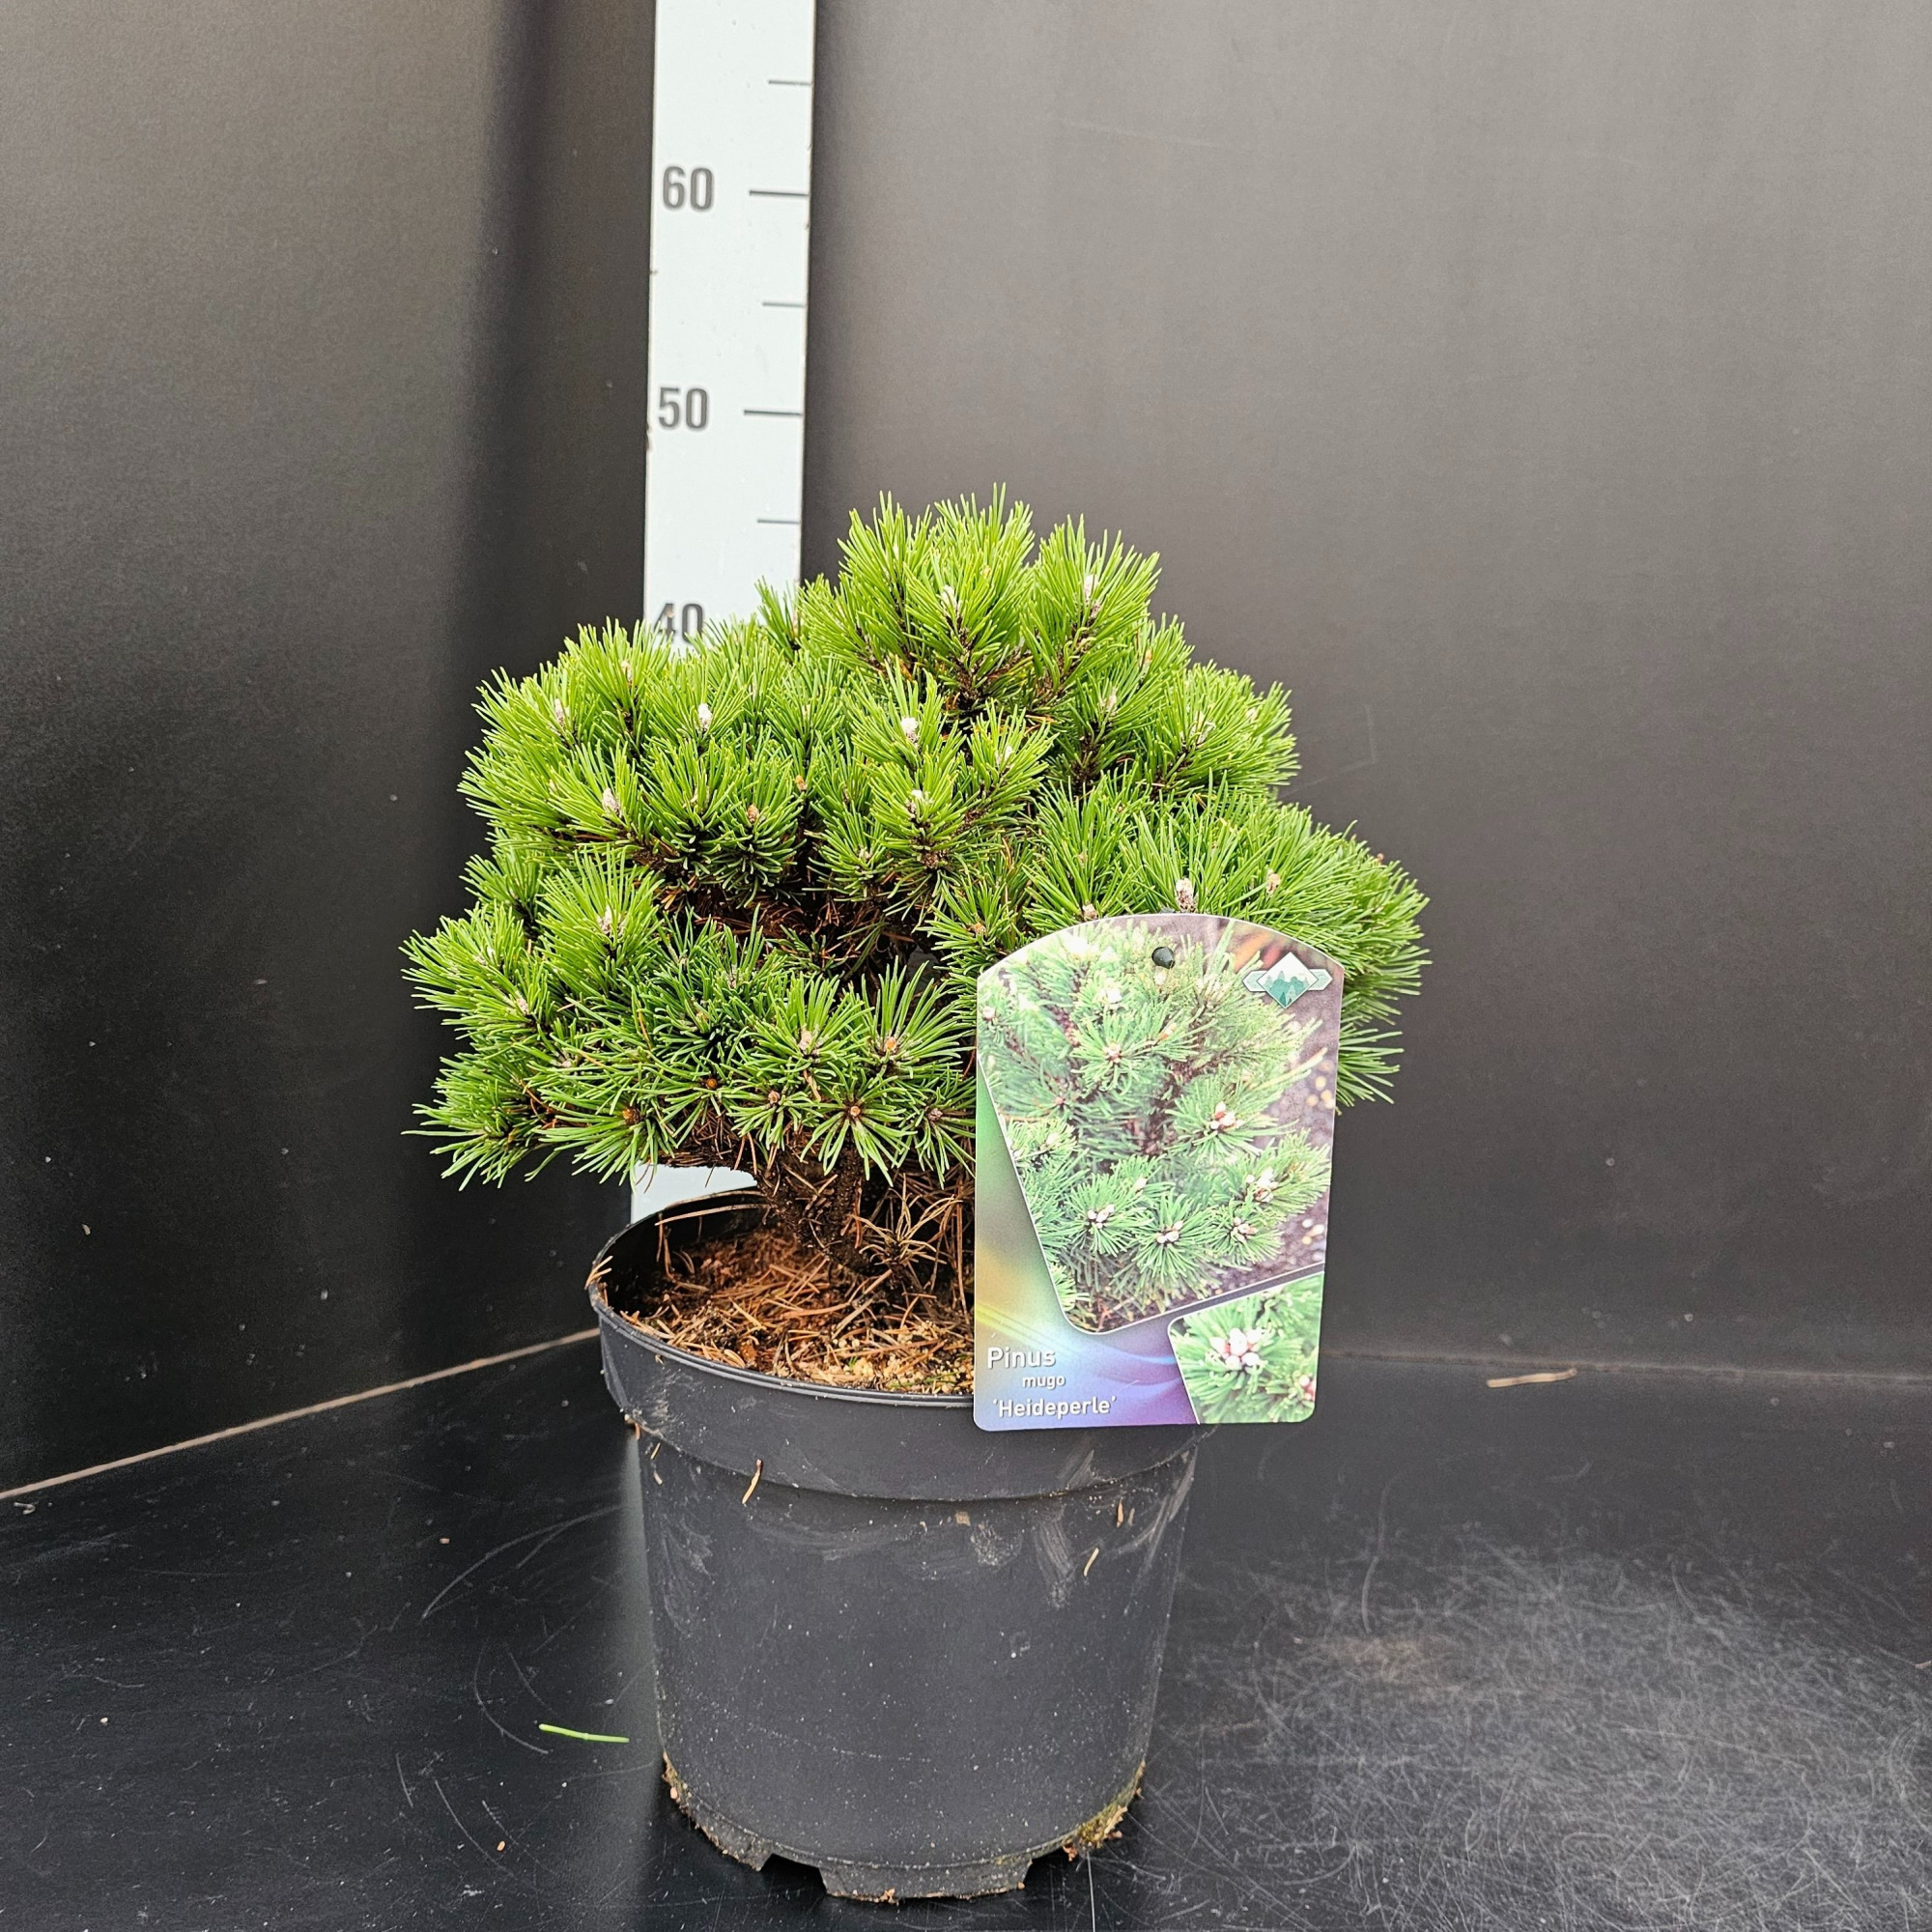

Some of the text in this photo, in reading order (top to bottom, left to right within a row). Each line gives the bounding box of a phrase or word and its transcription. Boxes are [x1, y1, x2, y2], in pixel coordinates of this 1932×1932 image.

[662, 166, 713, 212] 60
[658, 387, 709, 430] 50
[653, 603, 703, 651] 40
[987, 1348, 1056, 1369] Pinus
[1023, 1375, 1065, 1389] mugo
